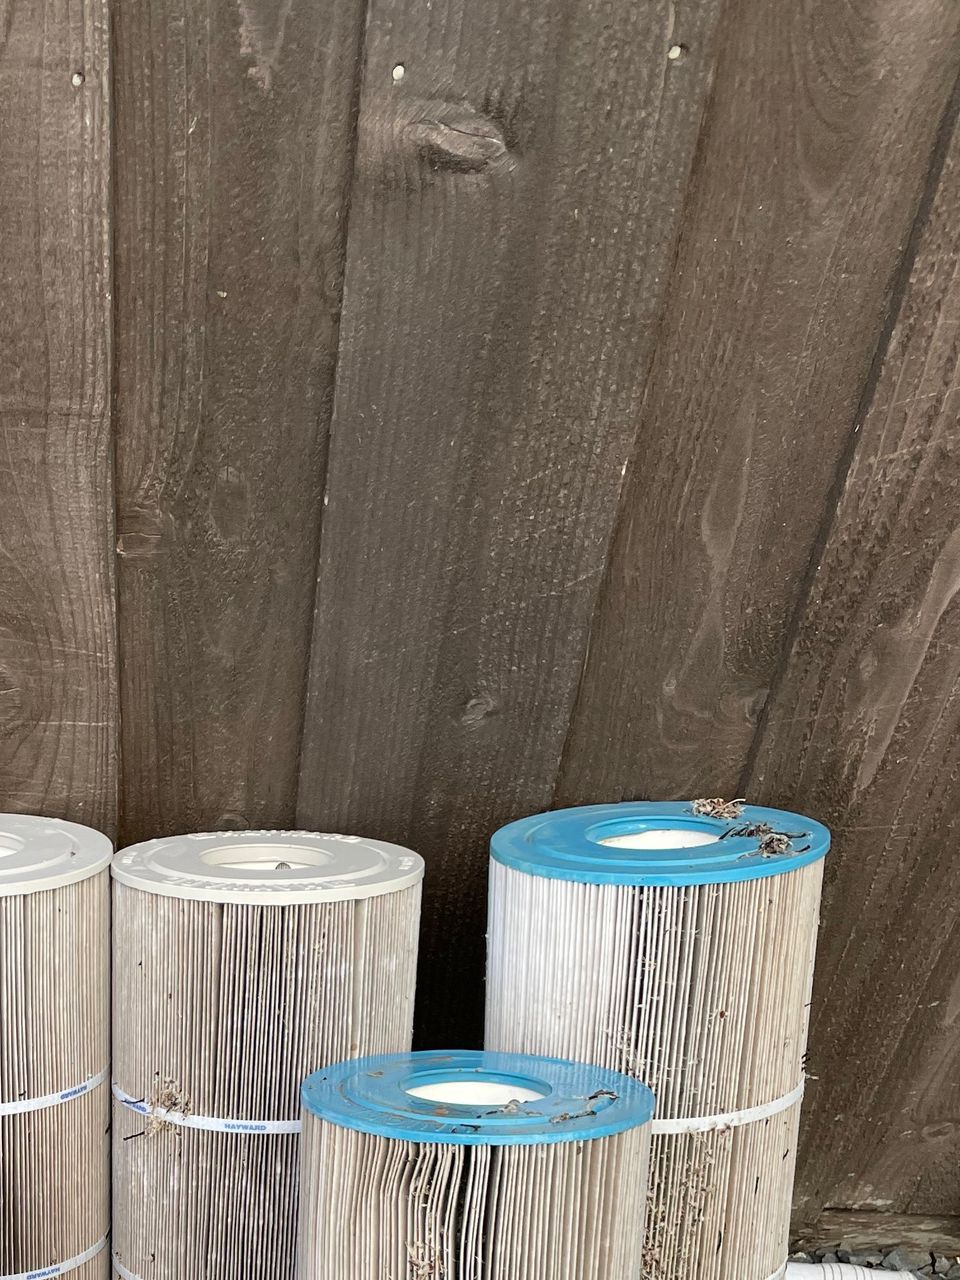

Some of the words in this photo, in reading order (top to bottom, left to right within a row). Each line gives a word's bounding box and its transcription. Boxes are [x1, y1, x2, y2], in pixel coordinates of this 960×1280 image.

[60, 1085, 88, 1100] HAYWARD
[224, 1123, 267, 1131] HAYWARD
[26, 1267, 61, 1280] HAYWARD
